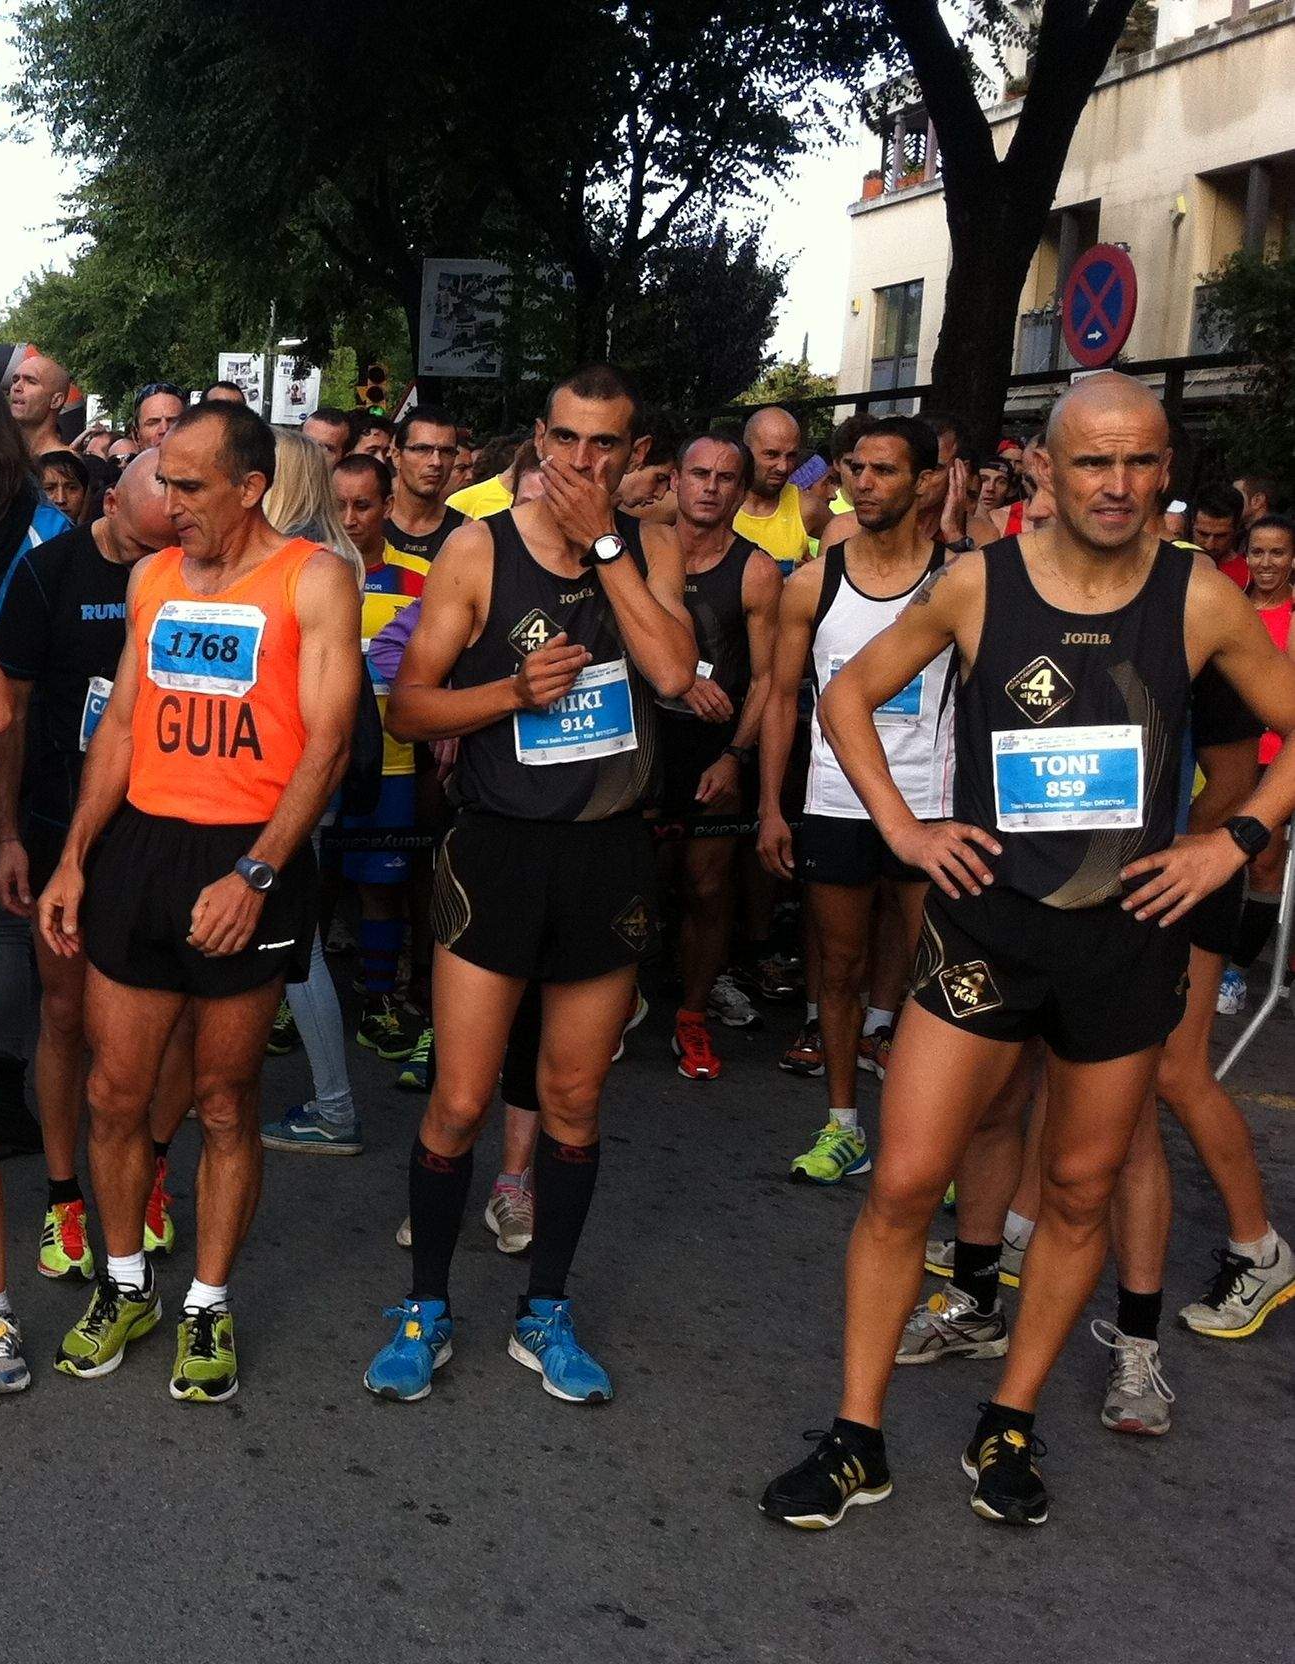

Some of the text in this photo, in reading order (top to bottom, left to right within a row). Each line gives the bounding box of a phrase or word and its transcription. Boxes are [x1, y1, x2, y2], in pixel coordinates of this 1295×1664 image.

[167, 631, 240, 663] 1768
[1061, 631, 1113, 646] Joma
[1028, 668, 1055, 697] 4
[548, 690, 603, 715] MIKI
[1026, 691, 1053, 707] Km
[157, 694, 264, 761] GUIA
[561, 714, 595, 733] 914
[1030, 753, 1100, 777] TONI
[1045, 780, 1086, 798] 859
